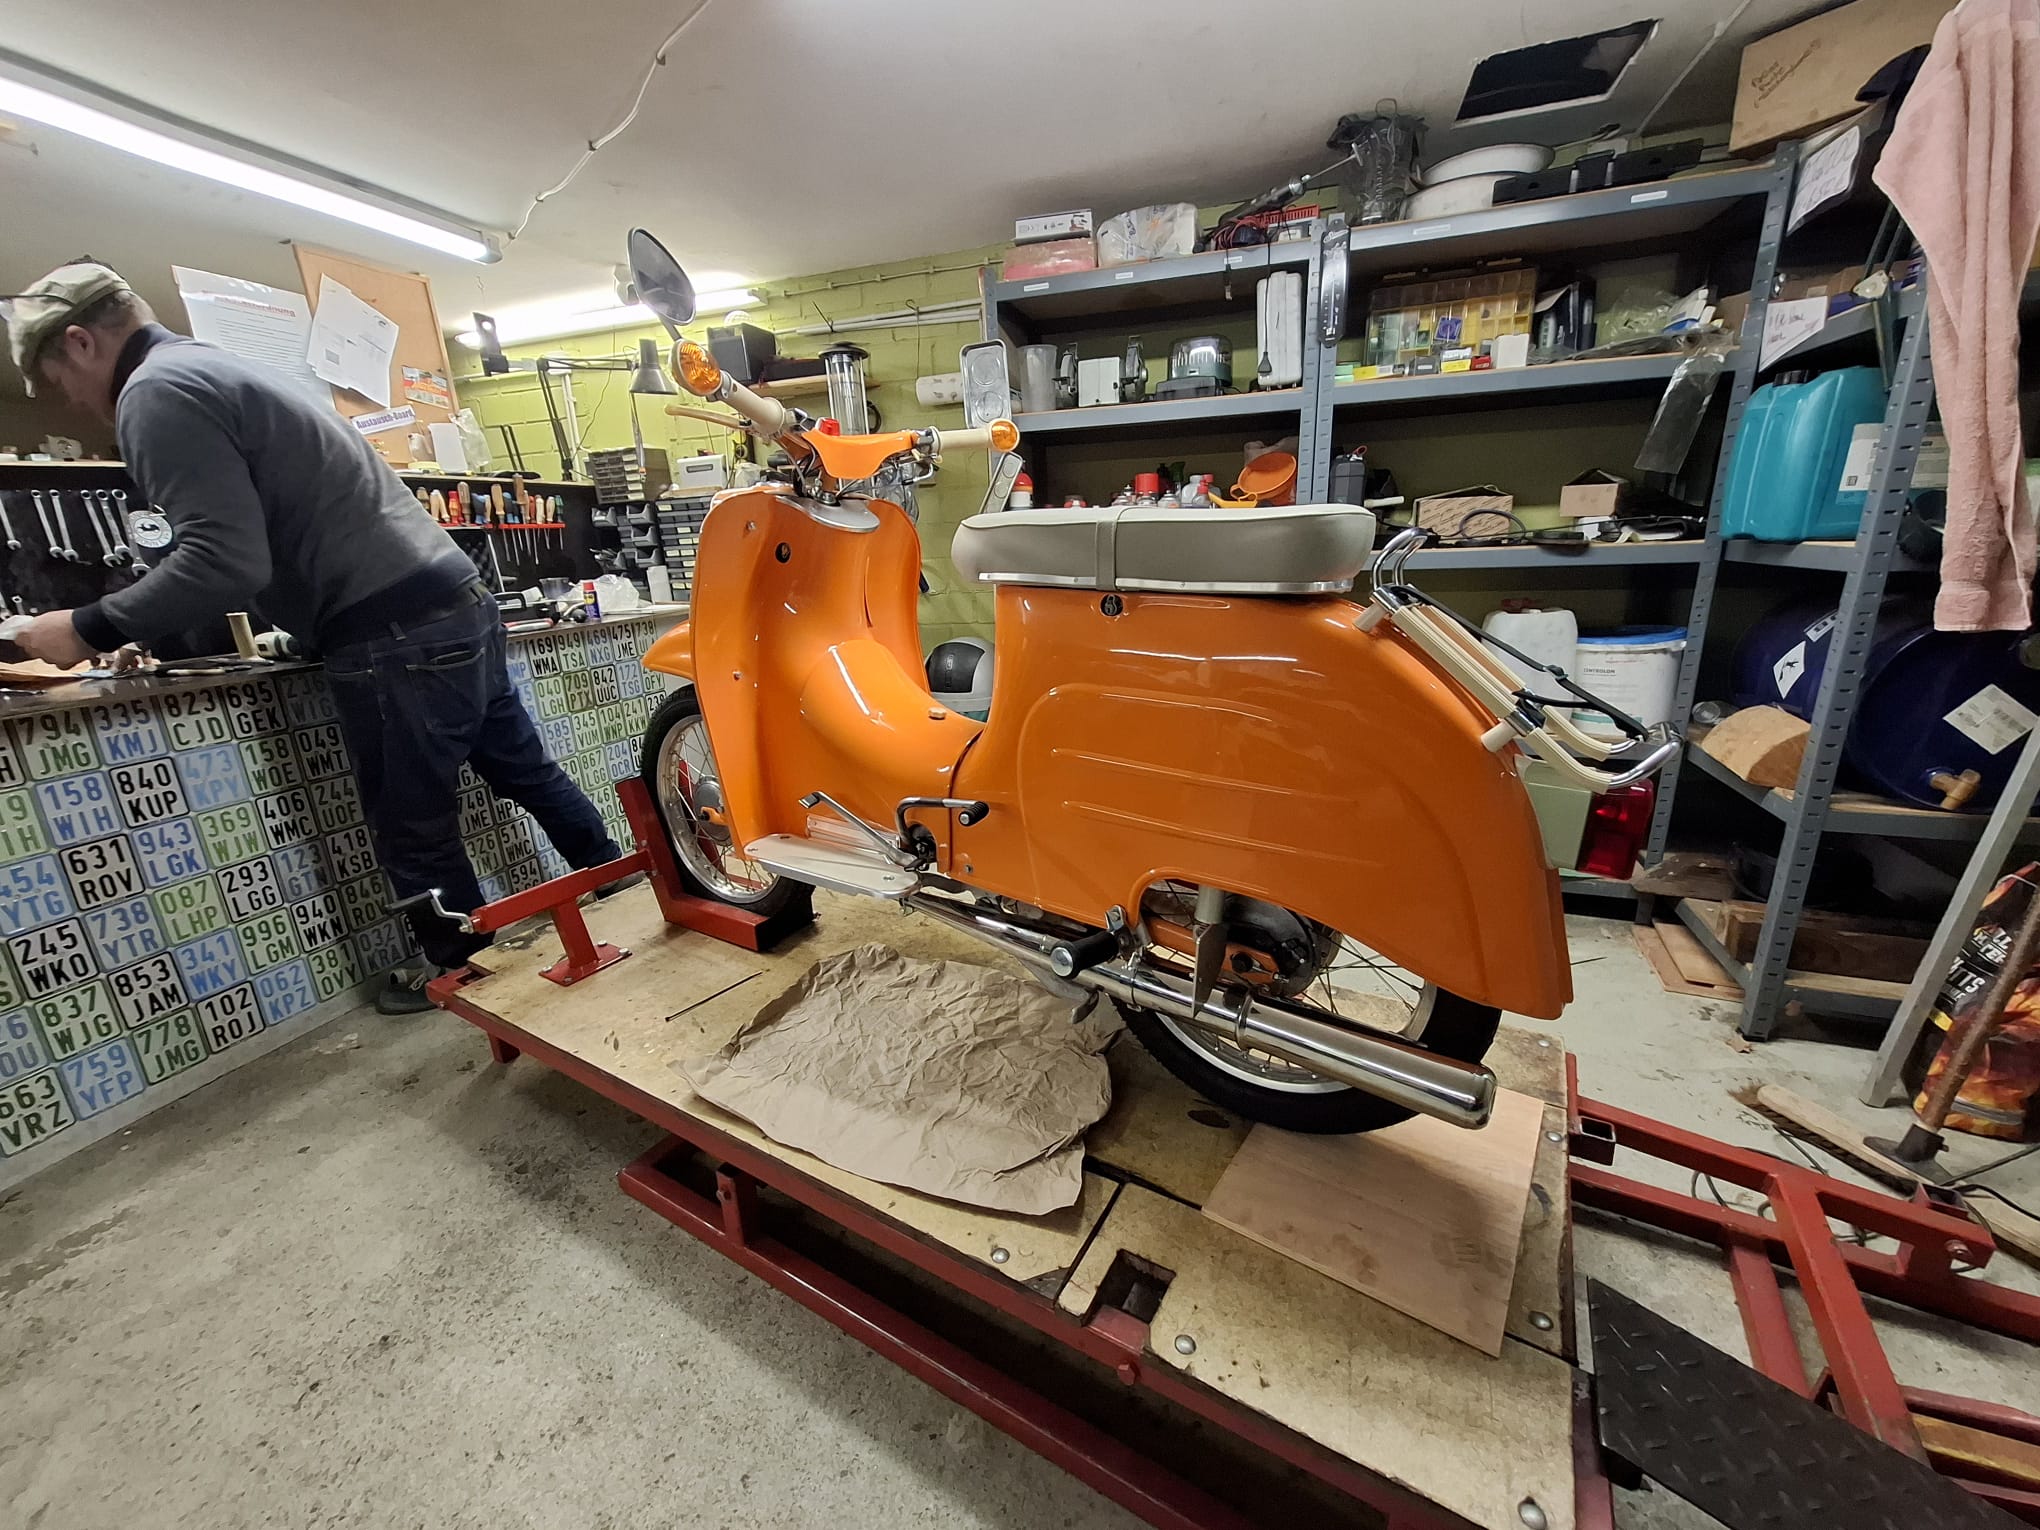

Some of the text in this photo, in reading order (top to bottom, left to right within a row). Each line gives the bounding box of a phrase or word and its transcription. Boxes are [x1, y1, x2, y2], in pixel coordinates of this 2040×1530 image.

[558, 632, 580, 650] 949
[587, 630, 607, 646] 469
[612, 623, 631, 641] 475
[635, 621, 653, 637] 738
[530, 636, 554, 656] 169
[563, 651, 585, 669] TSA
[618, 641, 635, 659] JME
[533, 656, 558, 675] WMA
[593, 668, 614, 685] 842
[620, 664, 638, 680] 172
[227, 680, 273, 709] 695
[537, 678, 561, 697] 040
[565, 673, 588, 692] 709
[597, 686, 617, 703] UUC
[621, 680, 640, 696] TSG
[164, 690, 216, 718] 823
[541, 697, 565, 717] LGH
[570, 691, 592, 710] PTX
[601, 705, 621, 724] 104
[624, 699, 644, 717] 241
[19, 710, 81, 745] 794
[95, 700, 150, 731] 335
[237, 707, 280, 735] GEK
[546, 720, 569, 740] 585
[574, 712, 596, 731] 345
[105, 729, 158, 760] KMJ
[172, 717, 224, 746] CJD
[299, 726, 340, 752] 049
[578, 729, 600, 748] VUM
[39, 742, 89, 775] JMG
[245, 737, 290, 765] 158
[551, 738, 573, 757] YFE
[582, 750, 601, 770] 867
[607, 742, 627, 761] 204
[185, 749, 233, 780] 473
[306, 750, 342, 776] WMT
[586, 768, 606, 787] LGG
[44, 776, 103, 811] 158
[116, 763, 171, 795] 840
[313, 779, 354, 806] 244
[128, 791, 178, 823] KUP
[263, 791, 305, 819] 406
[54, 806, 114, 841] WIH
[202, 811, 252, 838] 369
[269, 817, 314, 846] WMC
[465, 810, 490, 834] JME
[501, 821, 526, 843] 511
[140, 822, 192, 855] 943
[205, 831, 260, 864] WJW
[330, 830, 367, 857] 418
[467, 834, 495, 858] 326
[506, 840, 531, 862] WMC
[68, 839, 125, 875] 631
[149, 848, 202, 884] LGK
[281, 843, 320, 873] 123
[339, 851, 373, 879] KSB
[79, 868, 132, 905] ROV
[222, 861, 269, 894] 293
[511, 861, 537, 884] 594
[161, 880, 207, 914] 087
[232, 885, 276, 918] LGG
[346, 877, 381, 904] 846
[1, 890, 65, 929] YTG
[91, 902, 150, 940] 738
[173, 906, 218, 941] LHP
[295, 893, 337, 925] 940
[14, 924, 77, 966] 245
[242, 915, 287, 947] 996
[303, 918, 344, 948] WKN
[103, 929, 158, 964] YTR
[181, 934, 230, 970] 341
[251, 936, 296, 970] LGM
[312, 943, 351, 974] 381
[27, 953, 89, 993] WKO
[114, 959, 171, 997] 853
[189, 957, 237, 996] WKY
[262, 965, 302, 998] 062
[41, 985, 97, 1027] 837
[133, 983, 182, 1022] JAM
[204, 987, 252, 1022] 102
[269, 986, 311, 1022] KPZ
[52, 1013, 112, 1055] WJG
[136, 1014, 191, 1055] 778
[212, 1011, 256, 1048] ROJ
[67, 1044, 127, 1088] 759
[155, 1039, 200, 1078] JMG
[79, 1070, 133, 1111] YFP
[1, 1100, 68, 1147] VRZ
